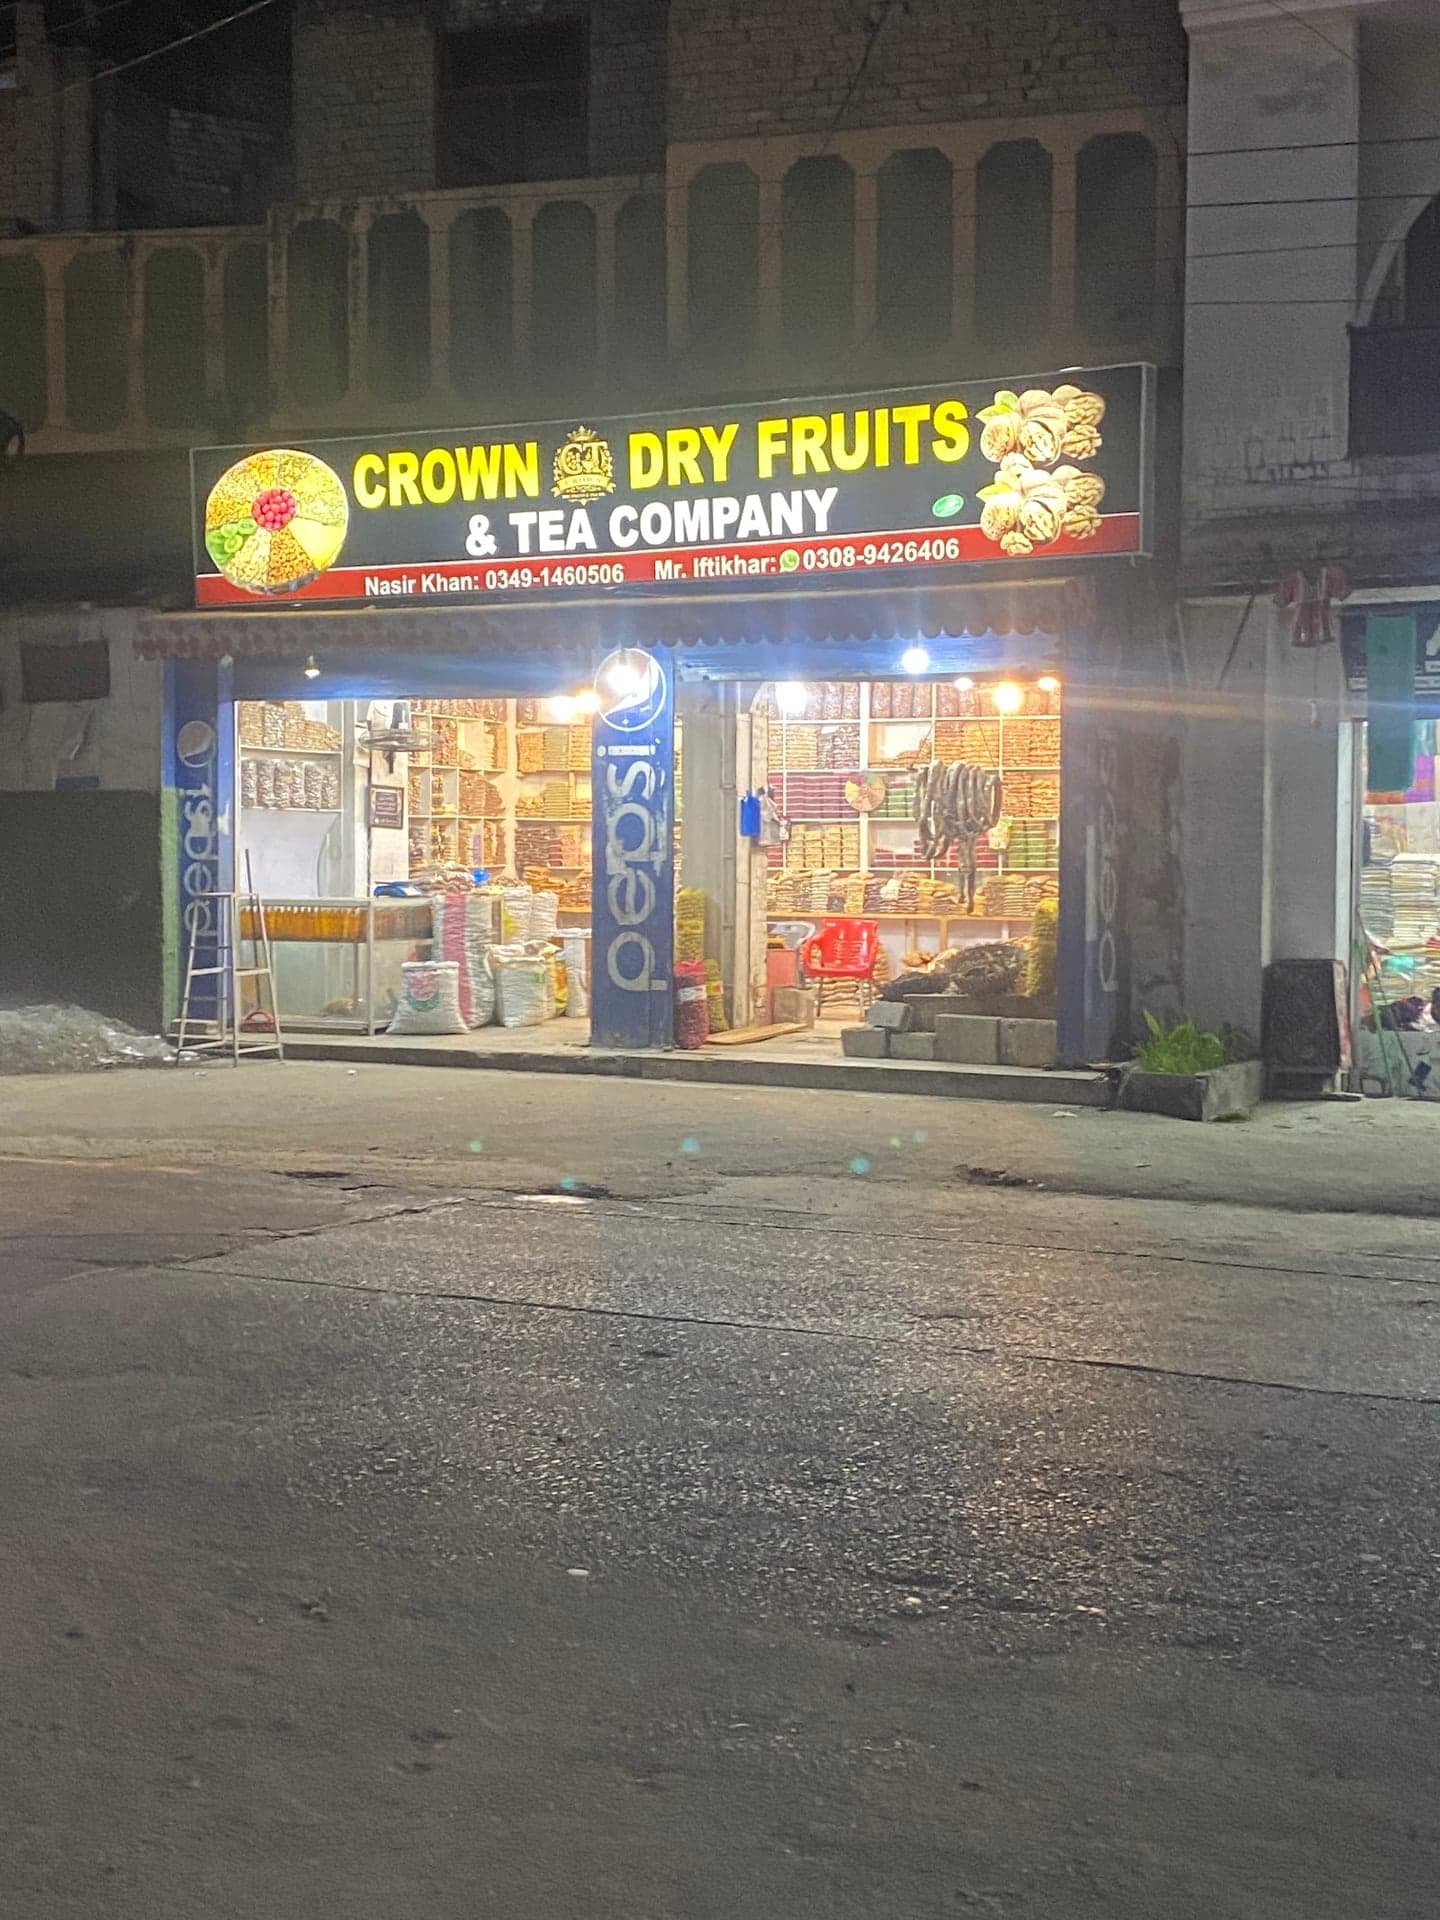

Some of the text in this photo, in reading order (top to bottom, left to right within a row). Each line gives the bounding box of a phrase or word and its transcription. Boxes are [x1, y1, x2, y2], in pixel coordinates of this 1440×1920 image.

[353, 401, 971, 509] CROWN DRY FRUITS
[465, 487, 839, 556] & TEA COMPANY
[364, 538, 960, 597] Nasir Khan: 0349-1460506 Mr. Iftikhar: 0308-9426406
[597, 744, 667, 992] pepsi
